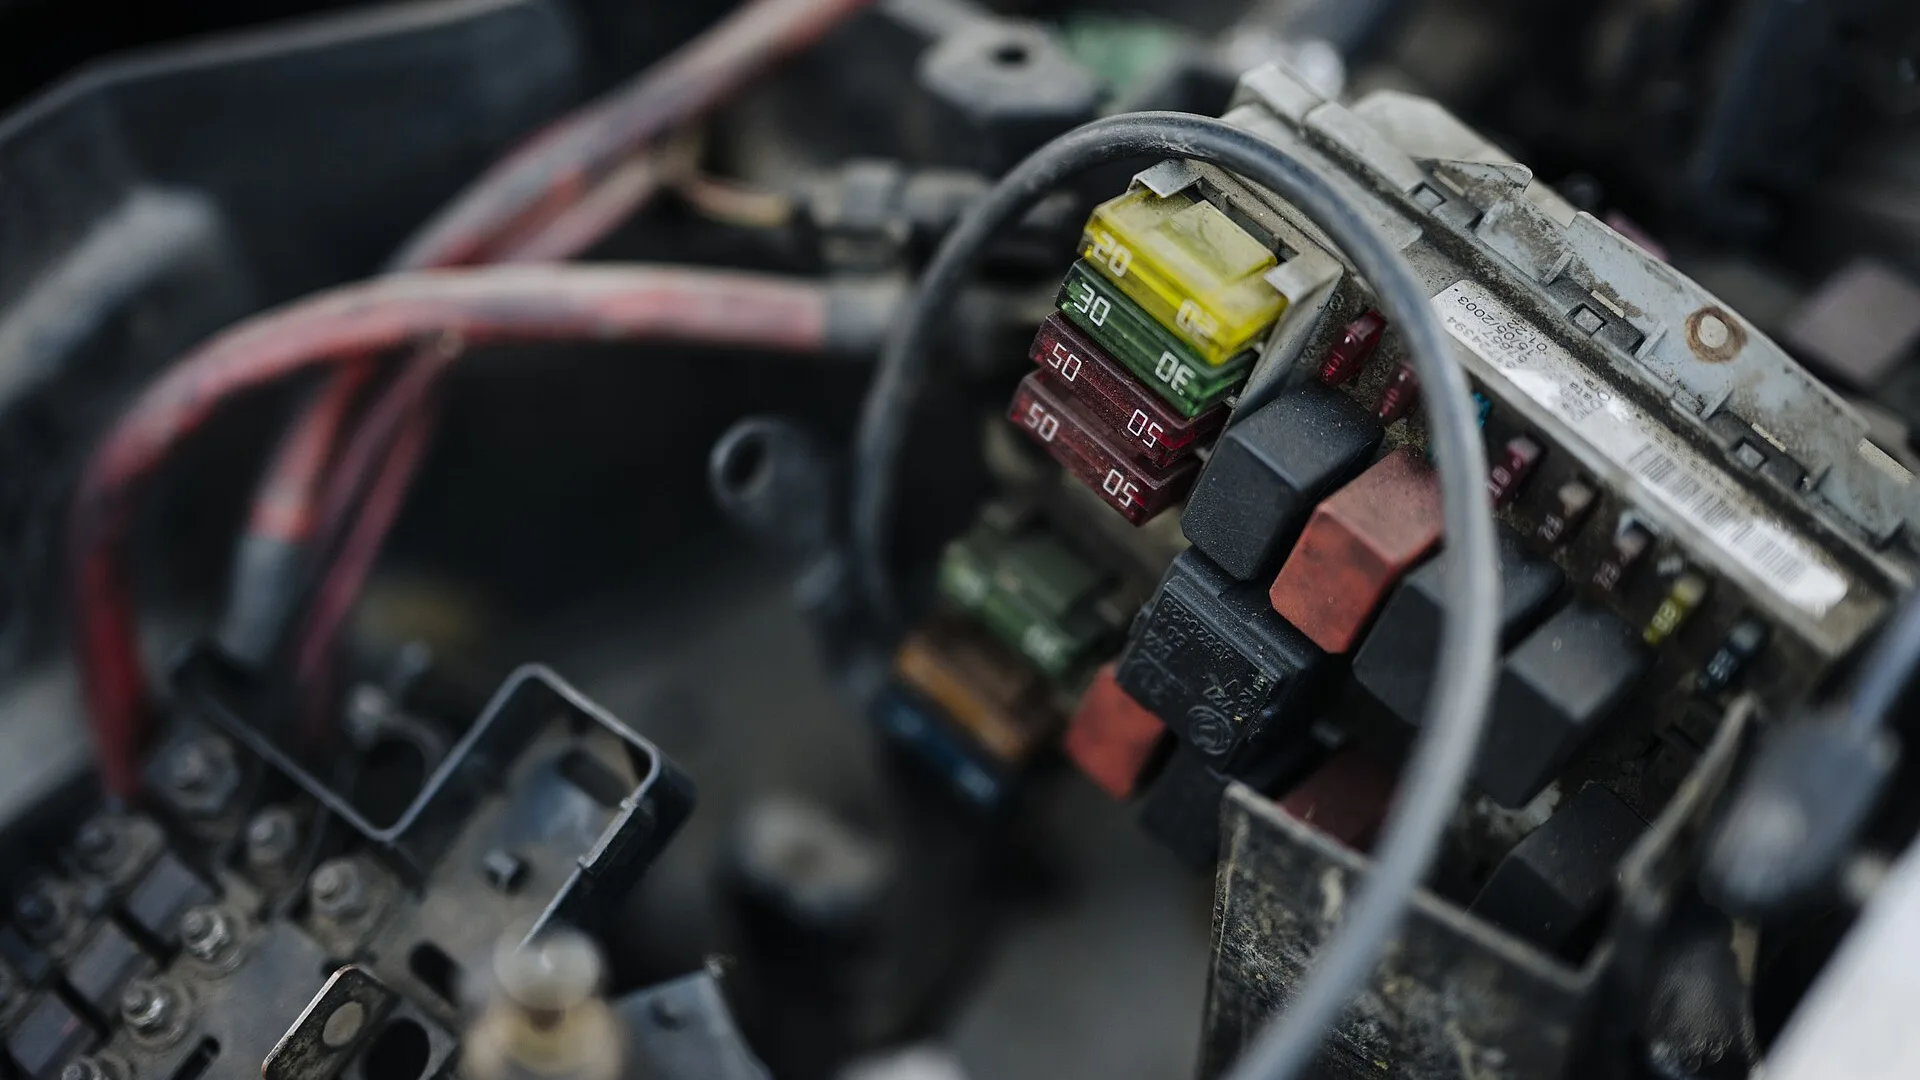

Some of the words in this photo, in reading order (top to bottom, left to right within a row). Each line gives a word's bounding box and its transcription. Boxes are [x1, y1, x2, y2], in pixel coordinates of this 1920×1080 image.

[1092, 231, 1132, 278] 20
[1073, 282, 1111, 327] 30
[1458, 296, 1533, 356] 15/05/2003
[1047, 342, 1082, 382] 50
[1154, 350, 1196, 396] 30
[1024, 402, 1060, 442] 50
[1127, 408, 1163, 449] 50
[1102, 468, 1139, 508] 50
